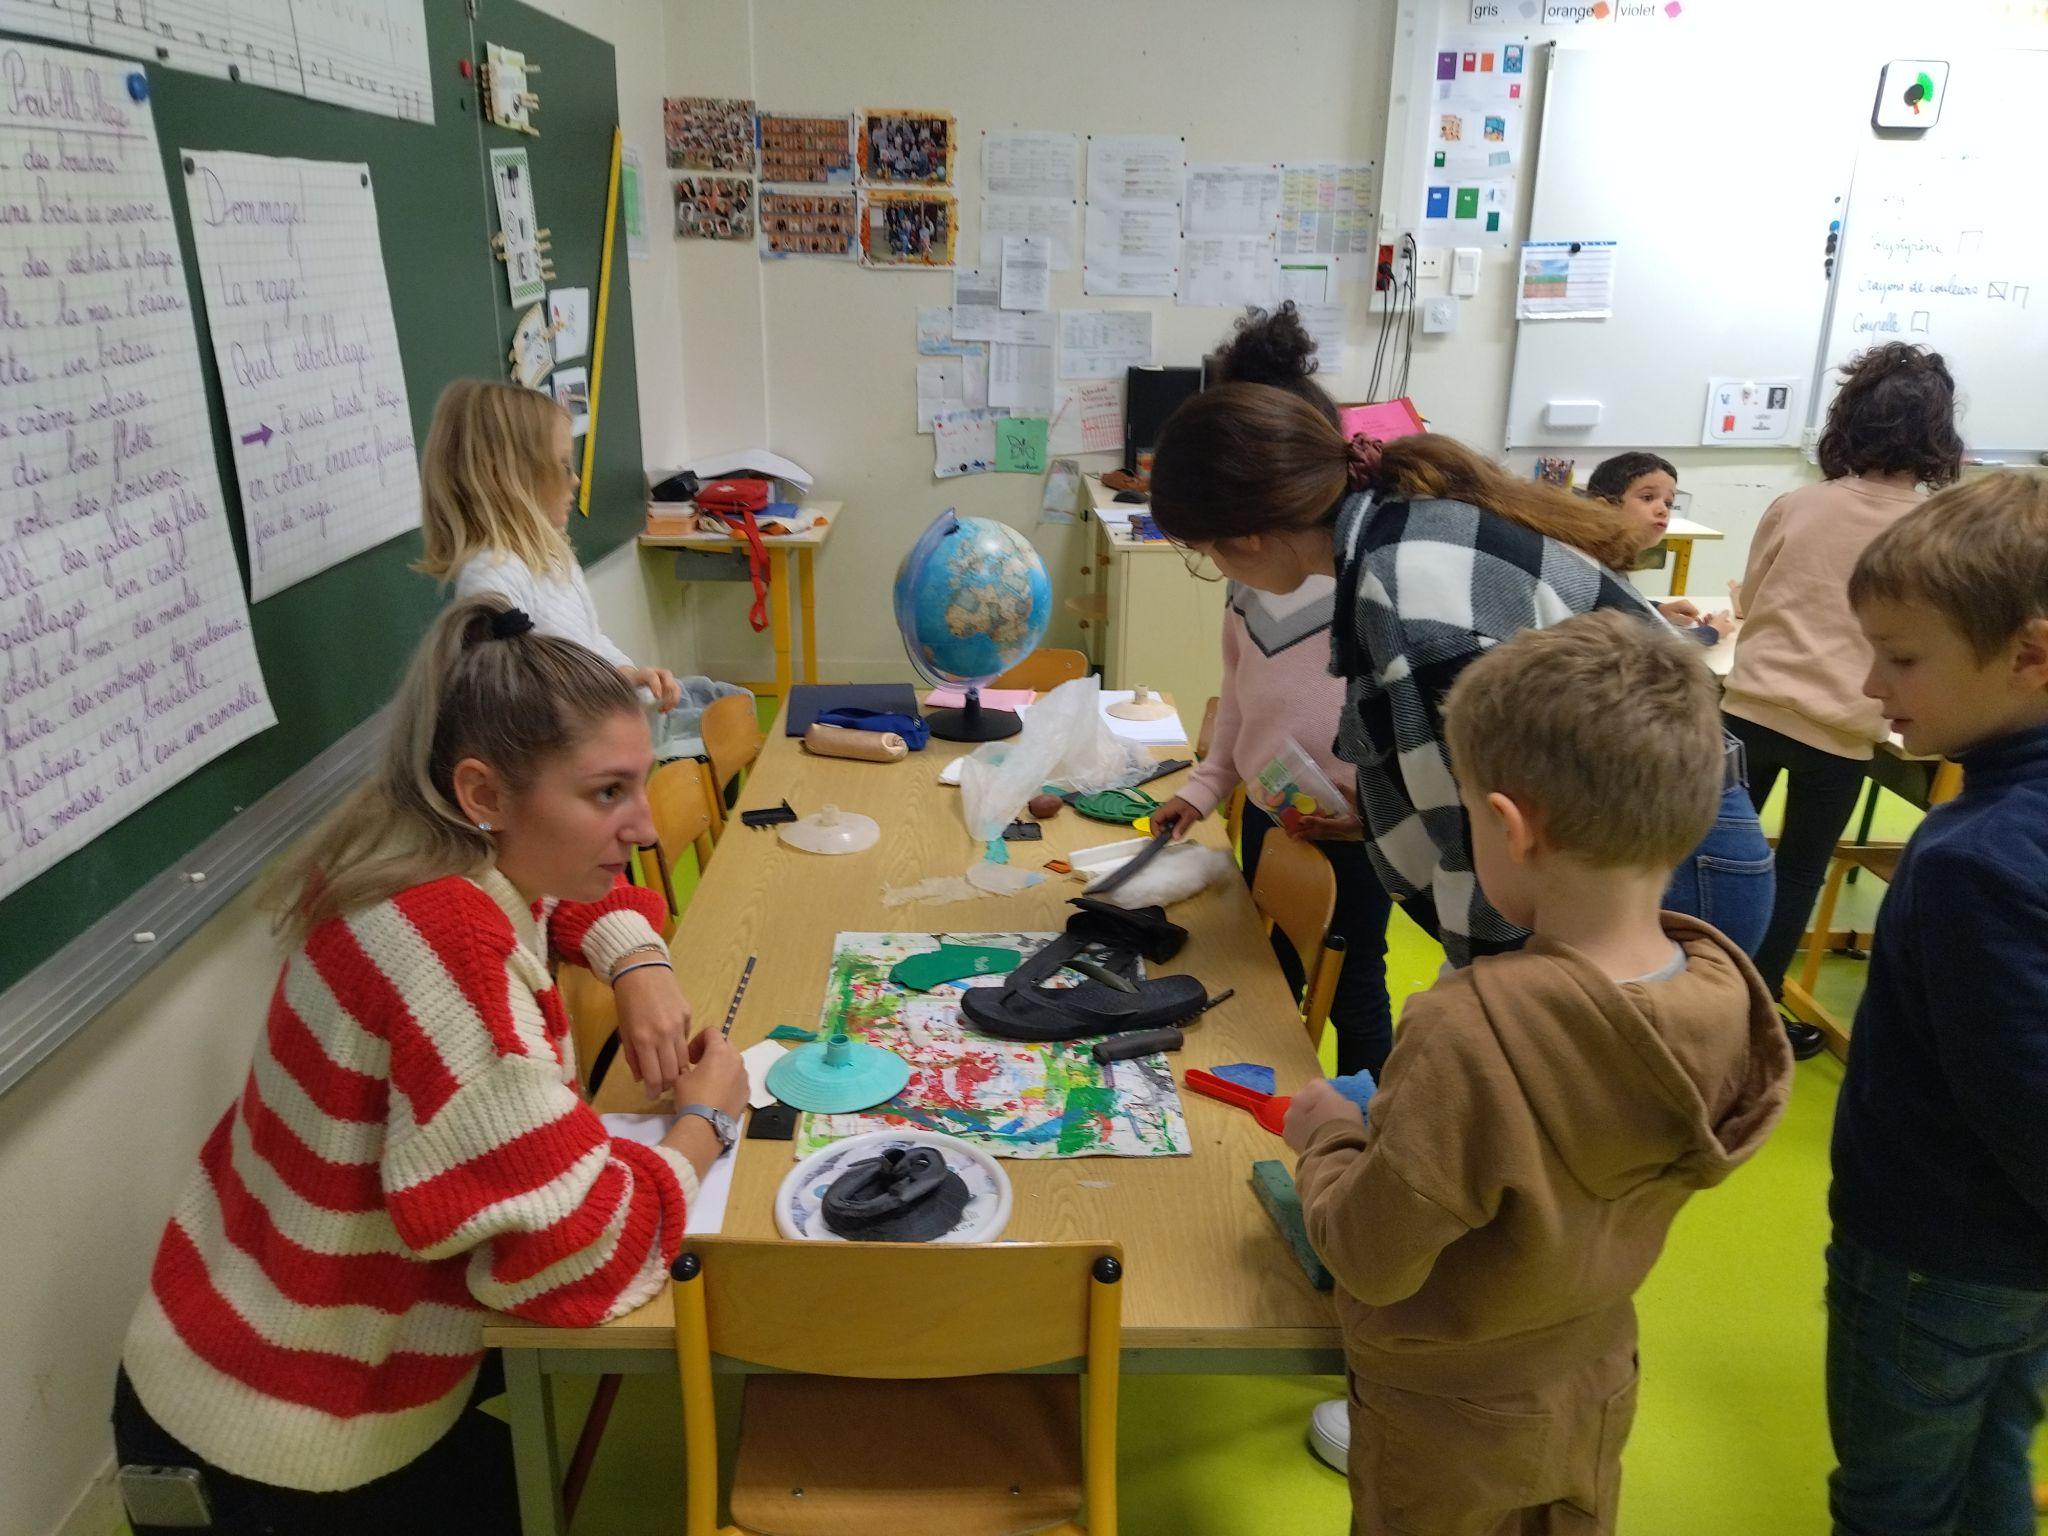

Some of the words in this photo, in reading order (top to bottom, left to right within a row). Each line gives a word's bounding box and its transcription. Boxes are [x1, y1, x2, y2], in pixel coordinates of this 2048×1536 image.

[1474, 5, 1498, 18] gris
[1548, 6, 1594, 19] orange
[1620, 4, 1656, 17] violet
[218, 263, 248, 307] La
[1909, 281, 1924, 294] de
[231, 321, 282, 390] Quel
[16, 402, 77, 436] crème
[88, 374, 149, 421] solaire
[12, 451, 52, 488] du
[248, 476, 269, 502] en
